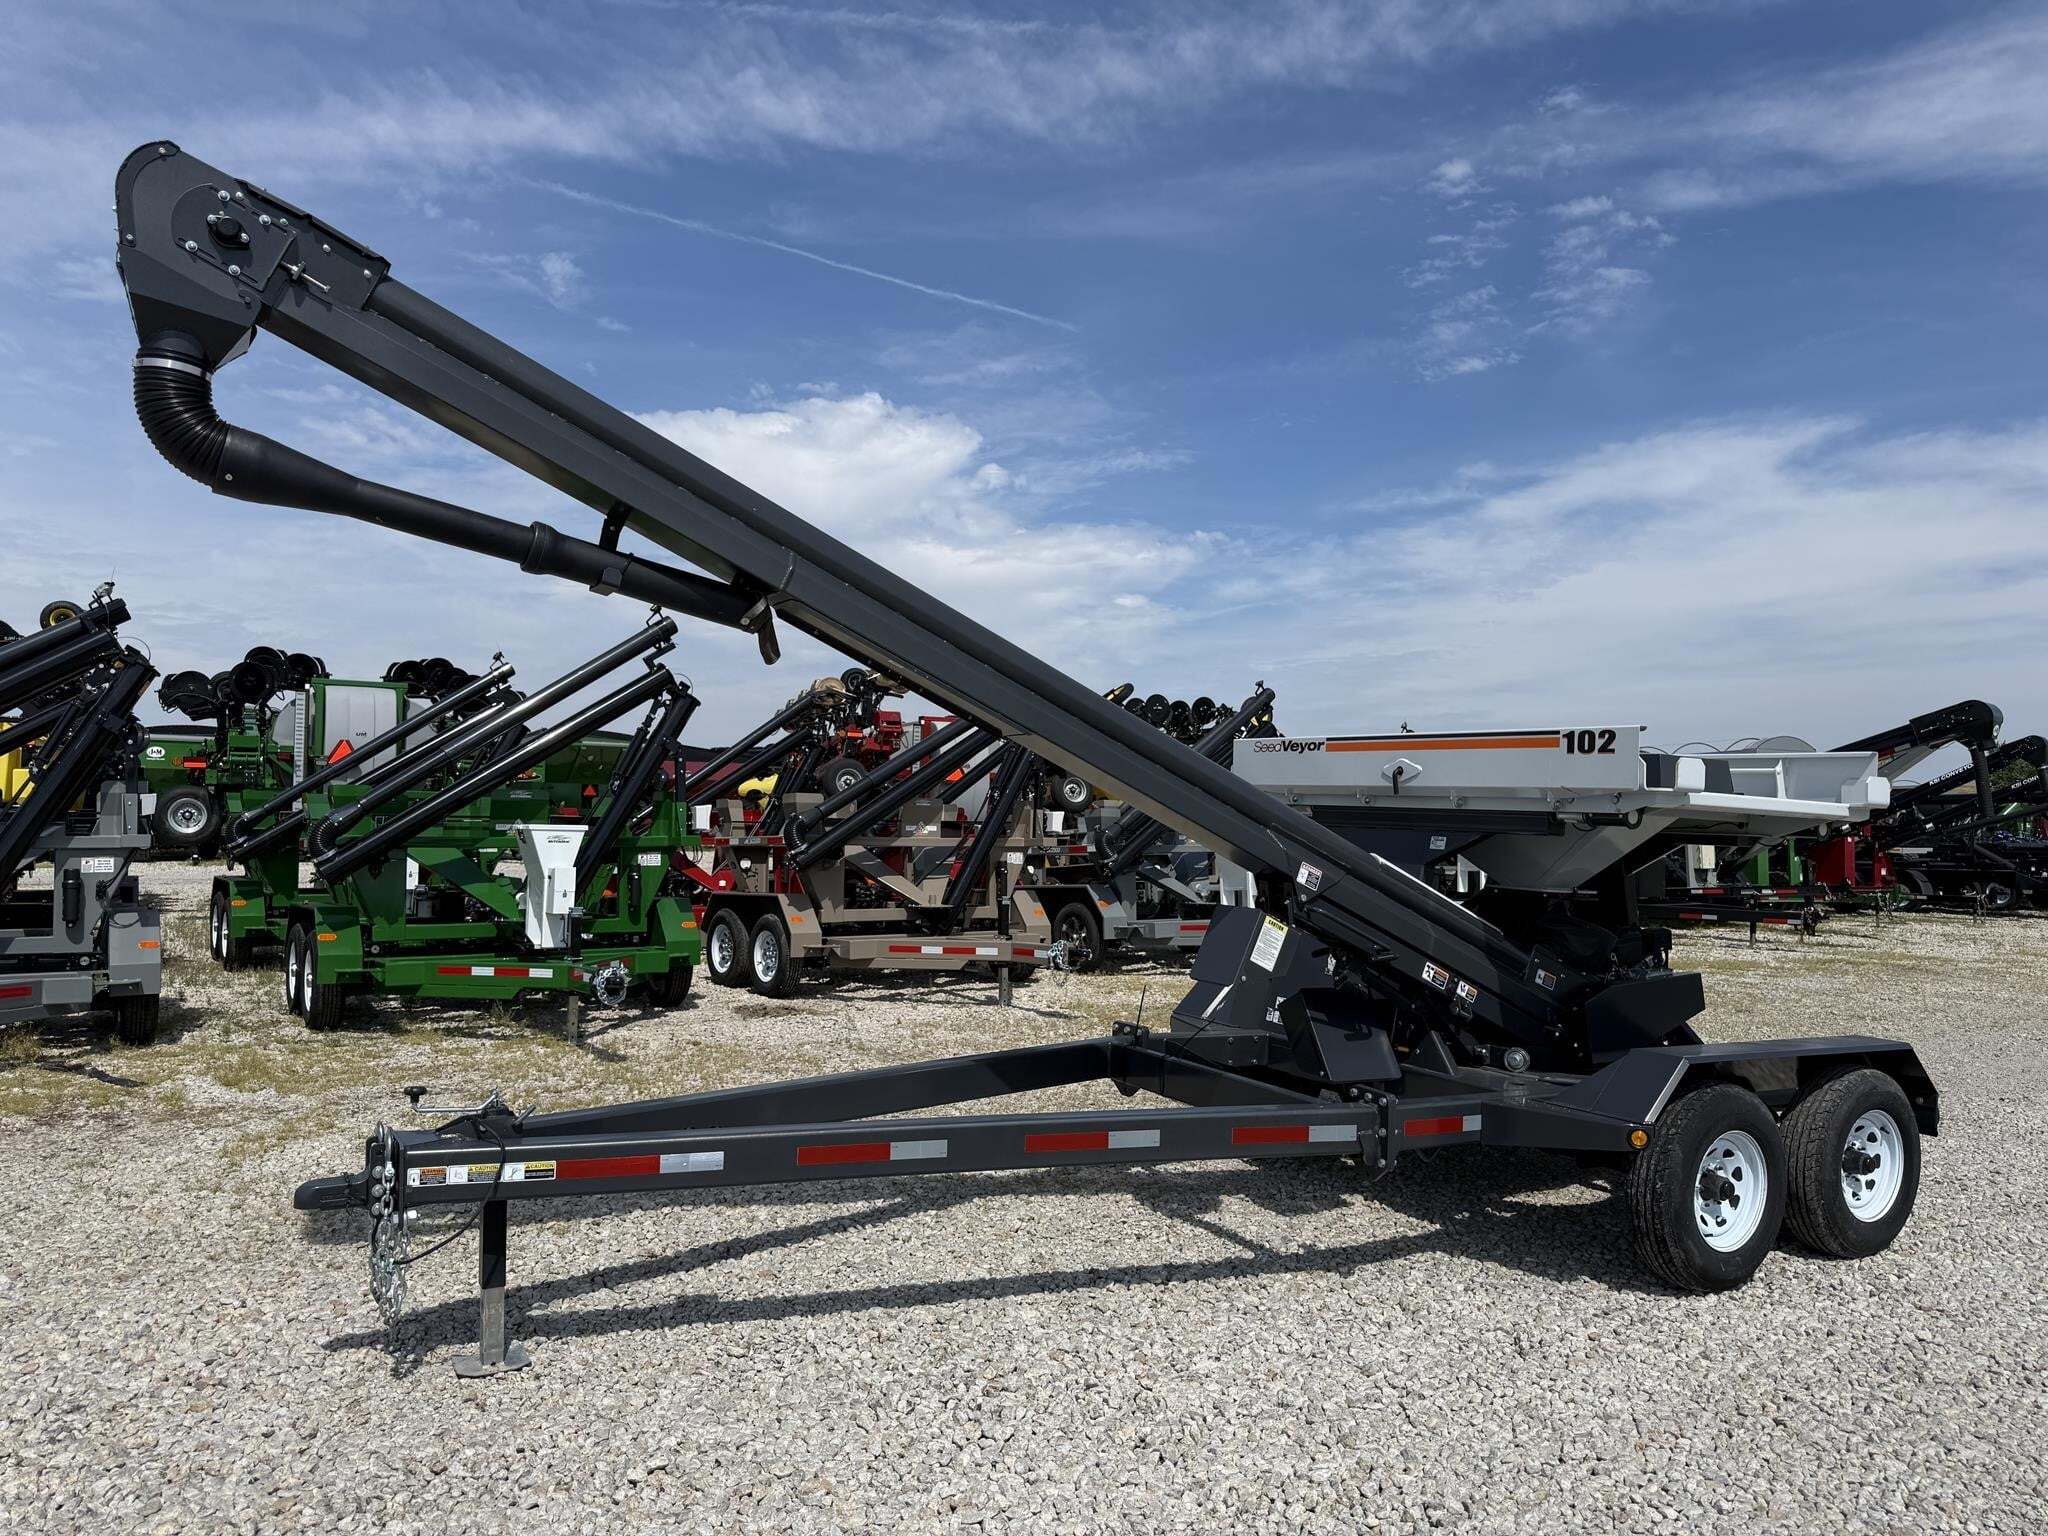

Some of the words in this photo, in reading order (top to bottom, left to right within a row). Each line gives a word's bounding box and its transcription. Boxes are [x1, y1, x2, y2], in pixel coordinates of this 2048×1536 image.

[1254, 740, 1325, 754] SeedVeyor
[1562, 729, 1616, 754] 102
[1268, 919, 1284, 931] CAUTION
